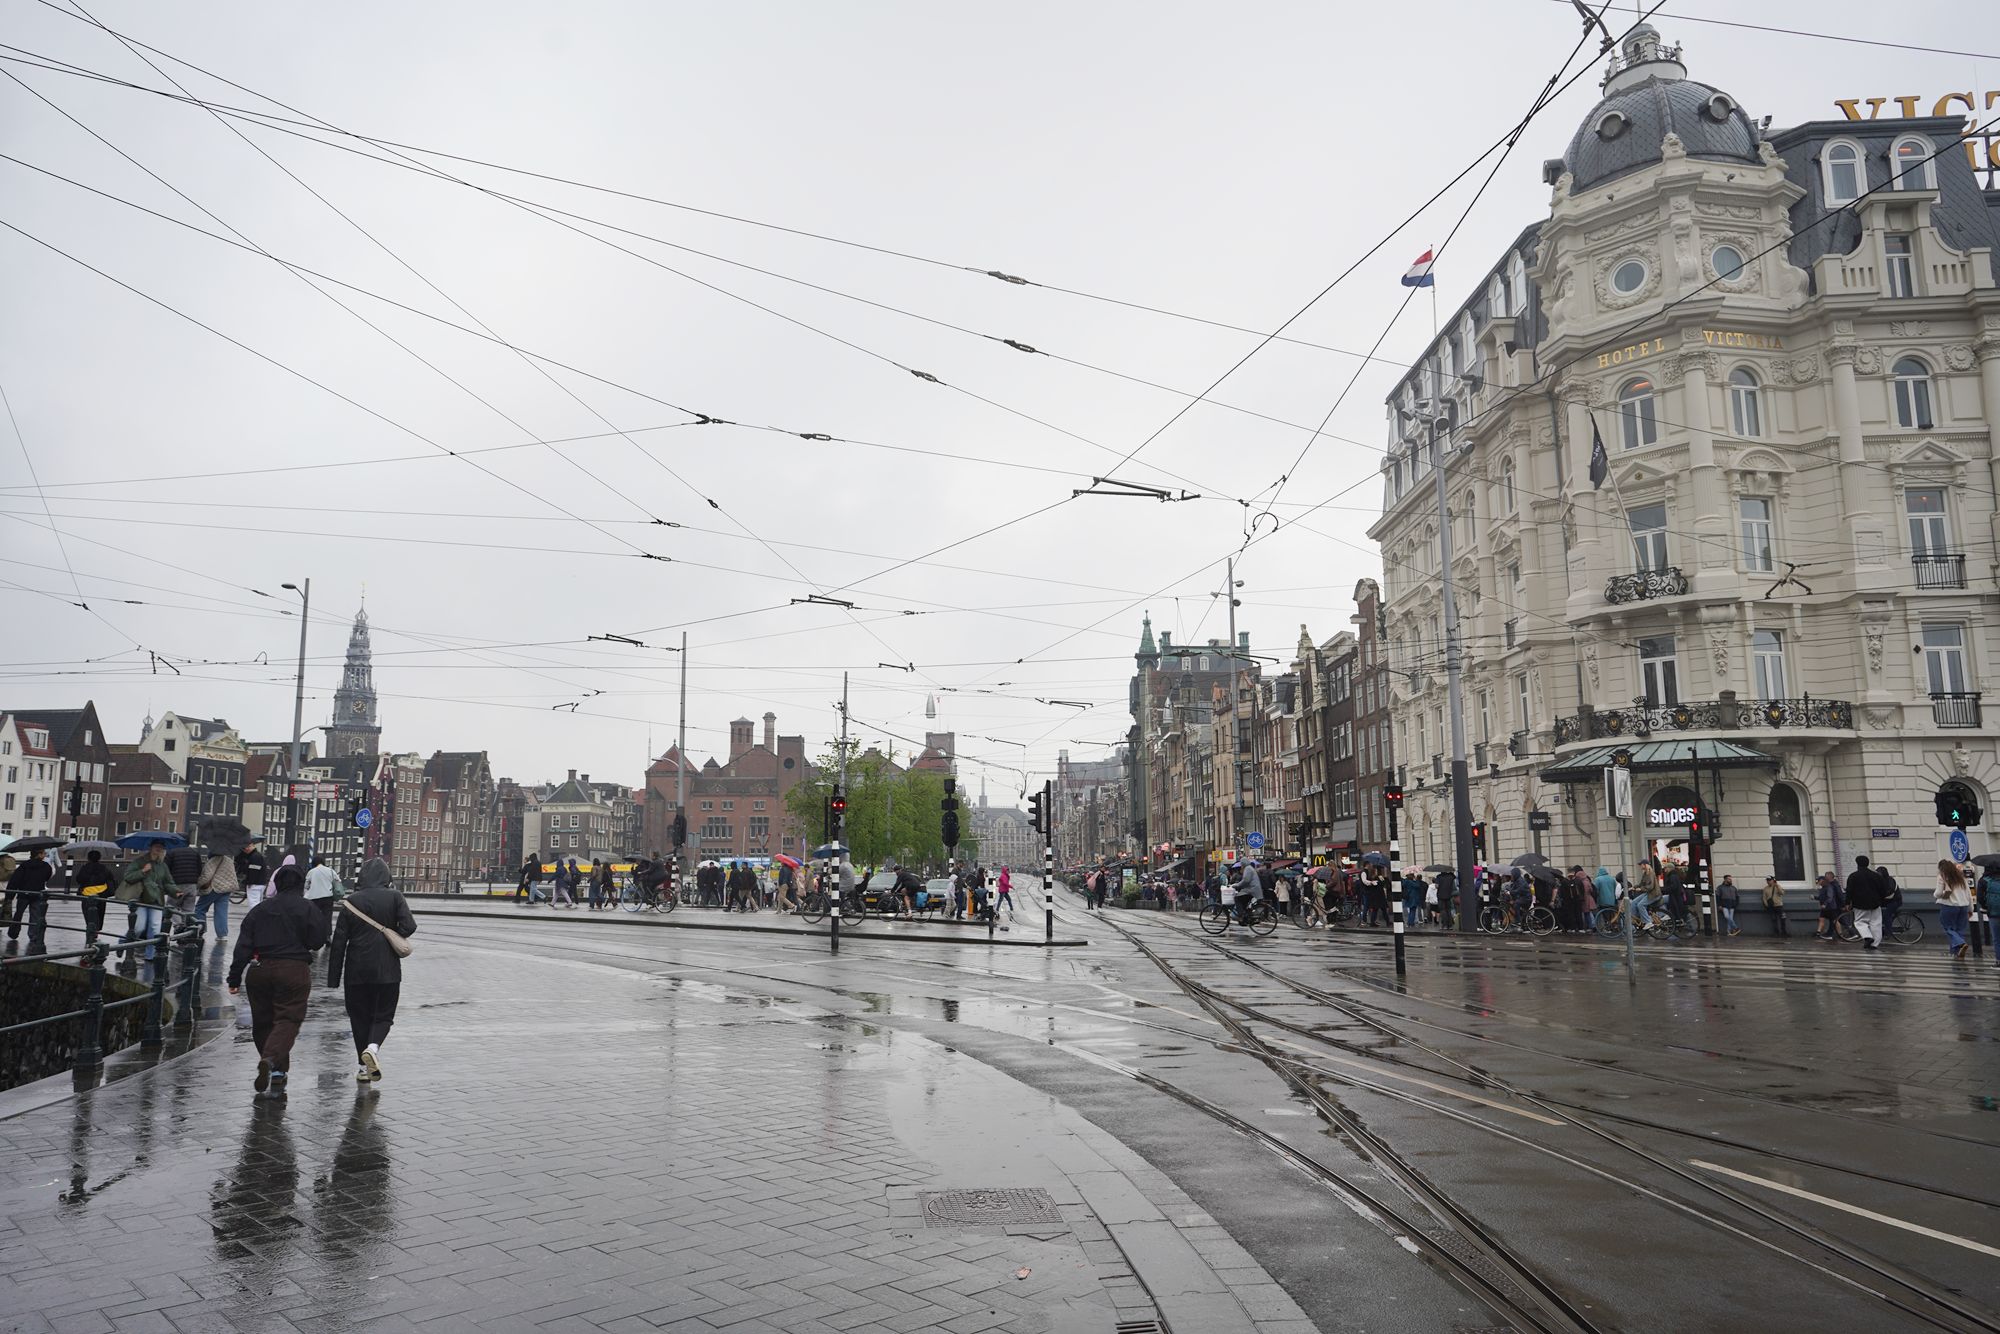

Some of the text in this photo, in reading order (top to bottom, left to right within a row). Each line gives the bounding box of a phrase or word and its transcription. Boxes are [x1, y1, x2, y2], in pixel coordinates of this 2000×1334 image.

[1597, 330, 1784, 369] HOTEL VICTORIA
[1650, 807, 1695, 826] snipes
